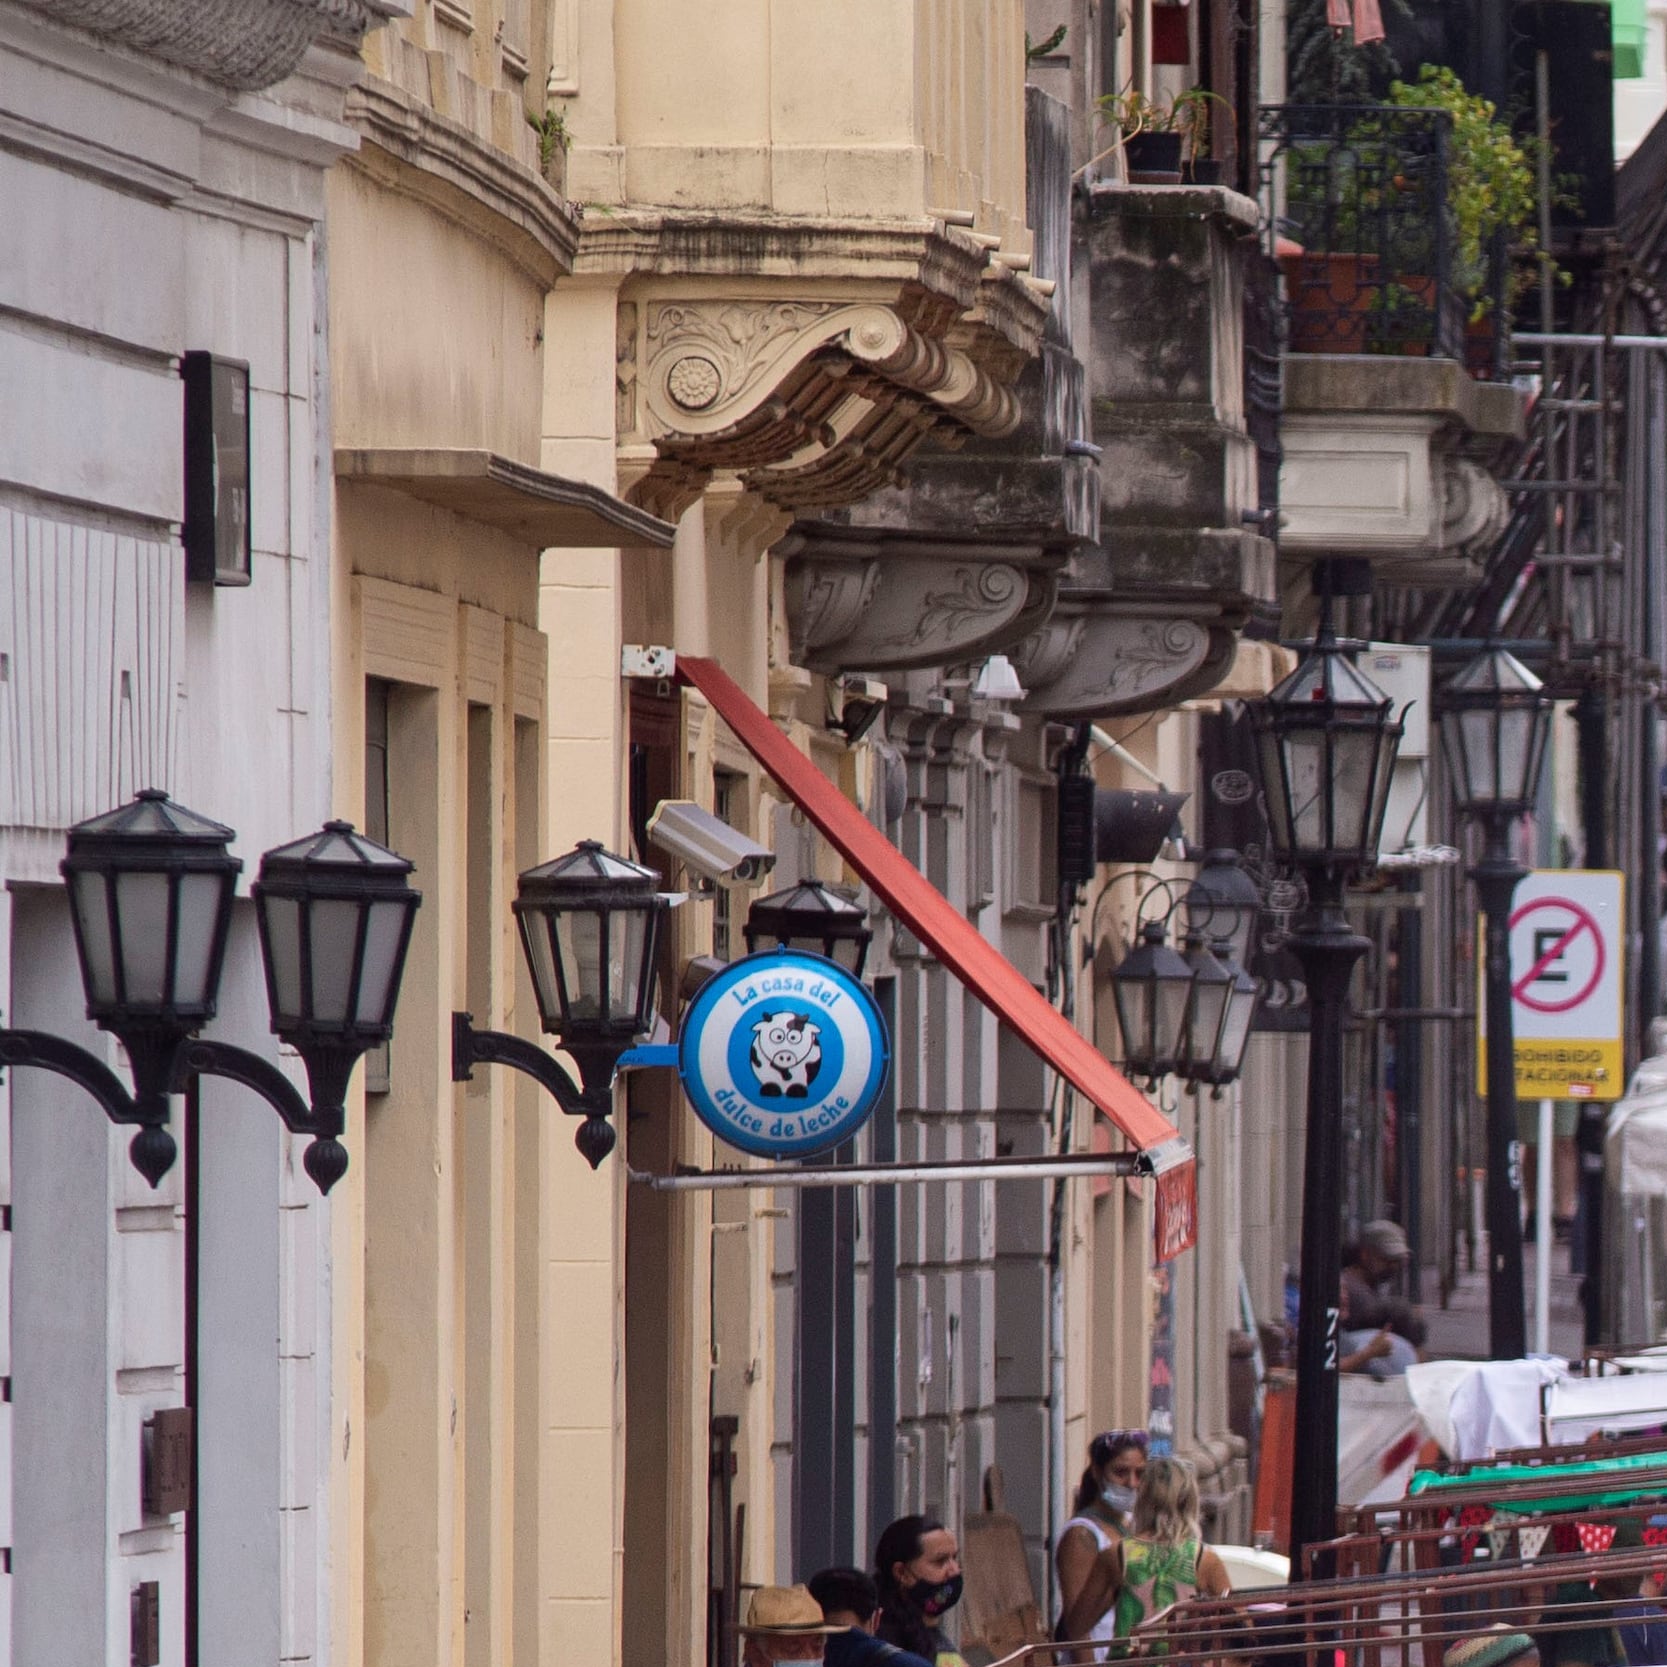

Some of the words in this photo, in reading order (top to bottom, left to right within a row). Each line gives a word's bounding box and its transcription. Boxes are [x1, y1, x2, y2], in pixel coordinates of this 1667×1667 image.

[1534, 927, 1568, 982] E
[732, 986, 757, 1006] La
[761, 977, 804, 992] casa
[809, 980, 842, 1008] del
[714, 1088, 763, 1133] dulce
[769, 1118, 795, 1137] de
[800, 1095, 849, 1134] leche
[1324, 1307, 1339, 1370] 72
